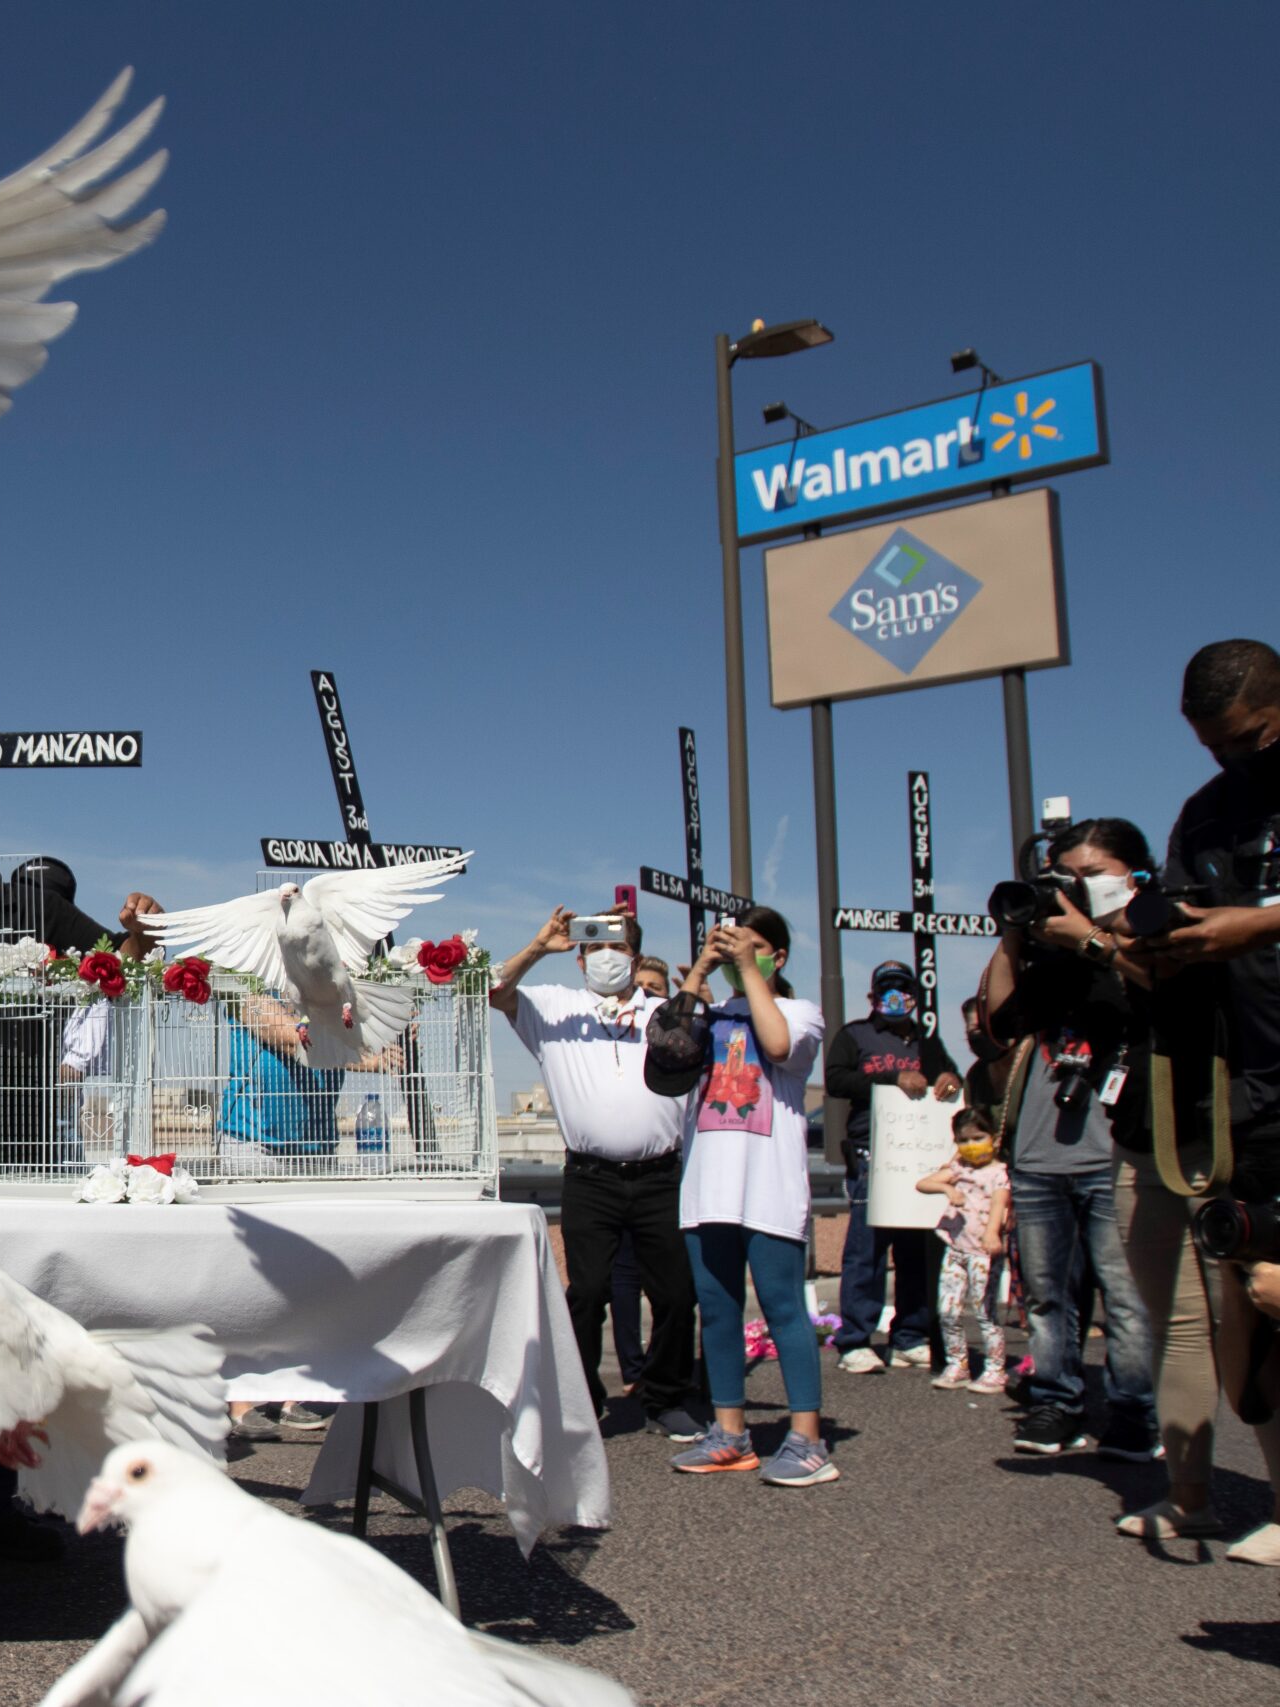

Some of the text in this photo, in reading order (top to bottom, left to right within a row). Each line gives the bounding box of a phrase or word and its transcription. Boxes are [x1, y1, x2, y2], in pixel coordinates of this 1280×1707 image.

[752, 416, 980, 513] Walmart
[850, 582, 960, 632] Sam's
[877, 617, 935, 640] CLUB
[12, 734, 138, 765] MANZANO
[318, 674, 369, 831] AUGUST 3rd
[685, 732, 700, 841] AUGUST
[267, 839, 330, 867] GLORIA
[329, 841, 377, 868] IRMA
[912, 773, 935, 898] AUGUST 3rd
[651, 871, 685, 900] ELSA
[834, 909, 998, 937] MARGIE RECKARD
[920, 948, 938, 1039] 2019
